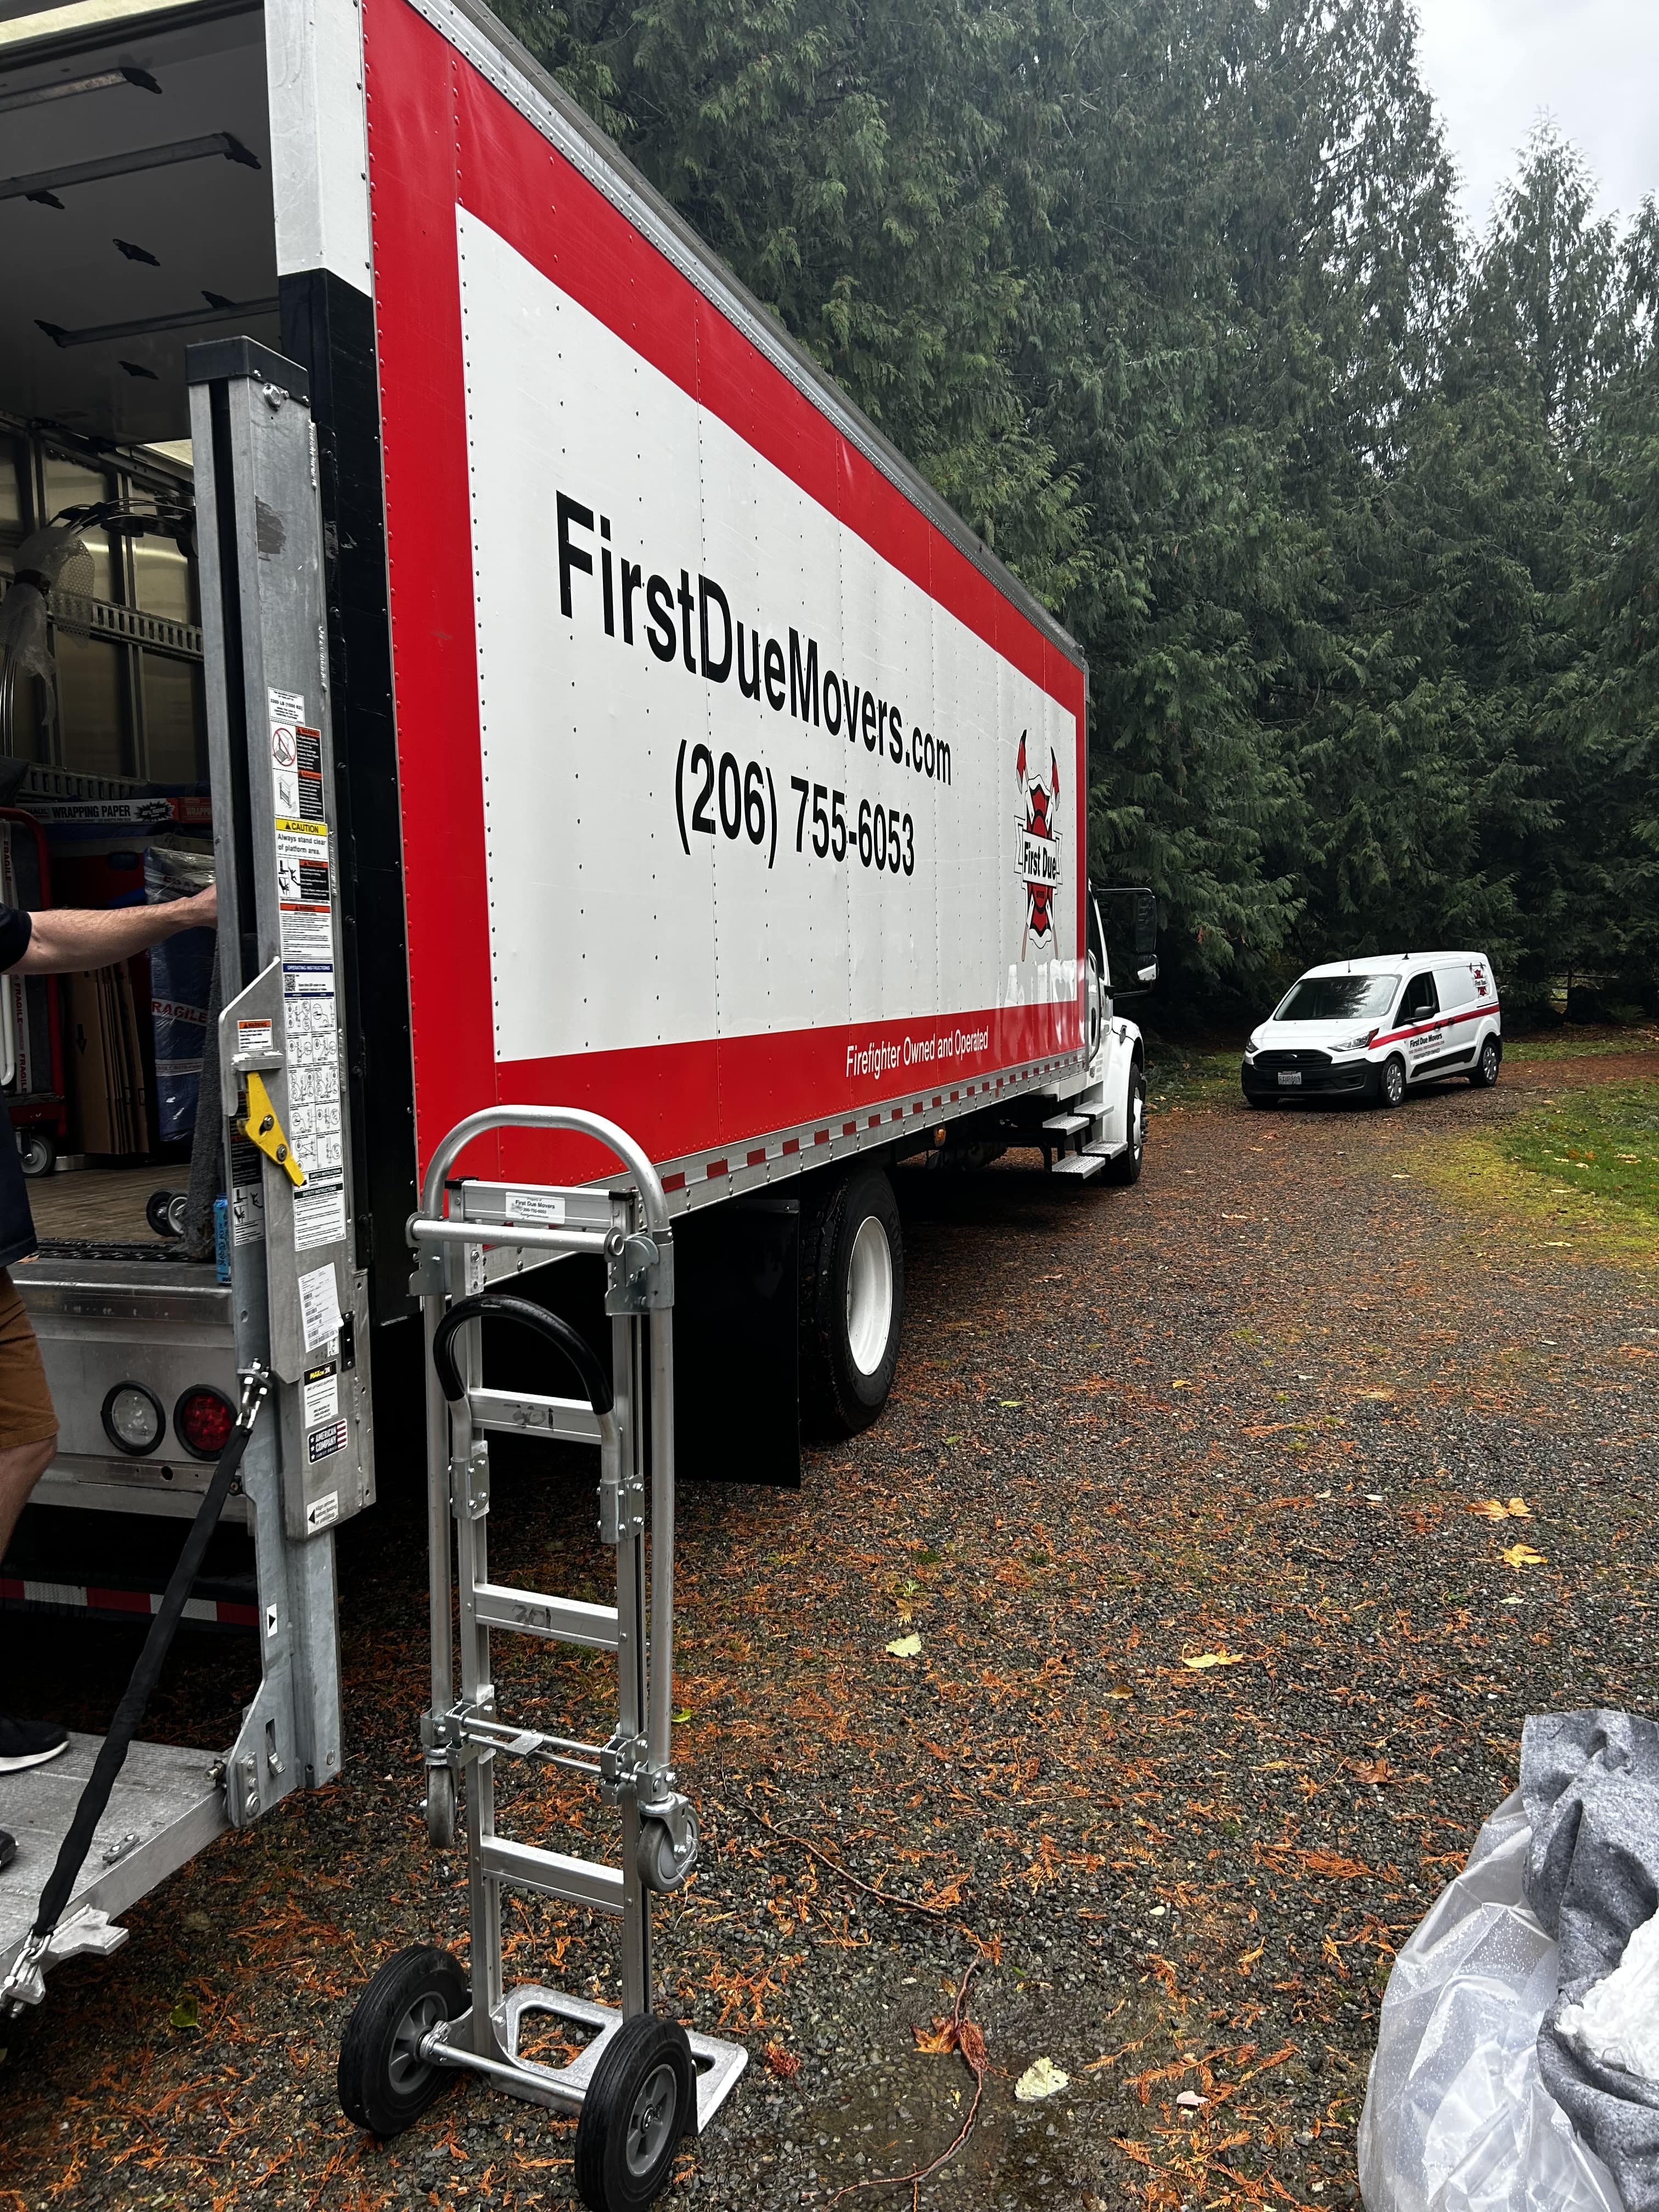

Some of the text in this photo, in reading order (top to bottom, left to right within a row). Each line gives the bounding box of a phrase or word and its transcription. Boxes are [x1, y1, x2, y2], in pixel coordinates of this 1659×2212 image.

[555, 489, 952, 786] FirstDueMovers.com
[53, 805, 99, 819] WRAPPING
[101, 805, 131, 817] PAPER
[291, 822, 319, 833] CAUTION
[675, 739, 915, 877] (206) 755-6053
[278, 833, 297, 843] Always
[1024, 841, 1057, 881] First Due
[14, 983, 24, 1024] FRAGILE
[845, 1025, 989, 1080] Firefighter Owned and Operated
[1410, 1038, 1420, 1048] First
[1420, 1036, 1428, 1045] Due
[1428, 1033, 1443, 1042] Movers
[19, 1053, 28, 1094] FRAGILE
[315, 1435, 337, 1453] COMPANY
